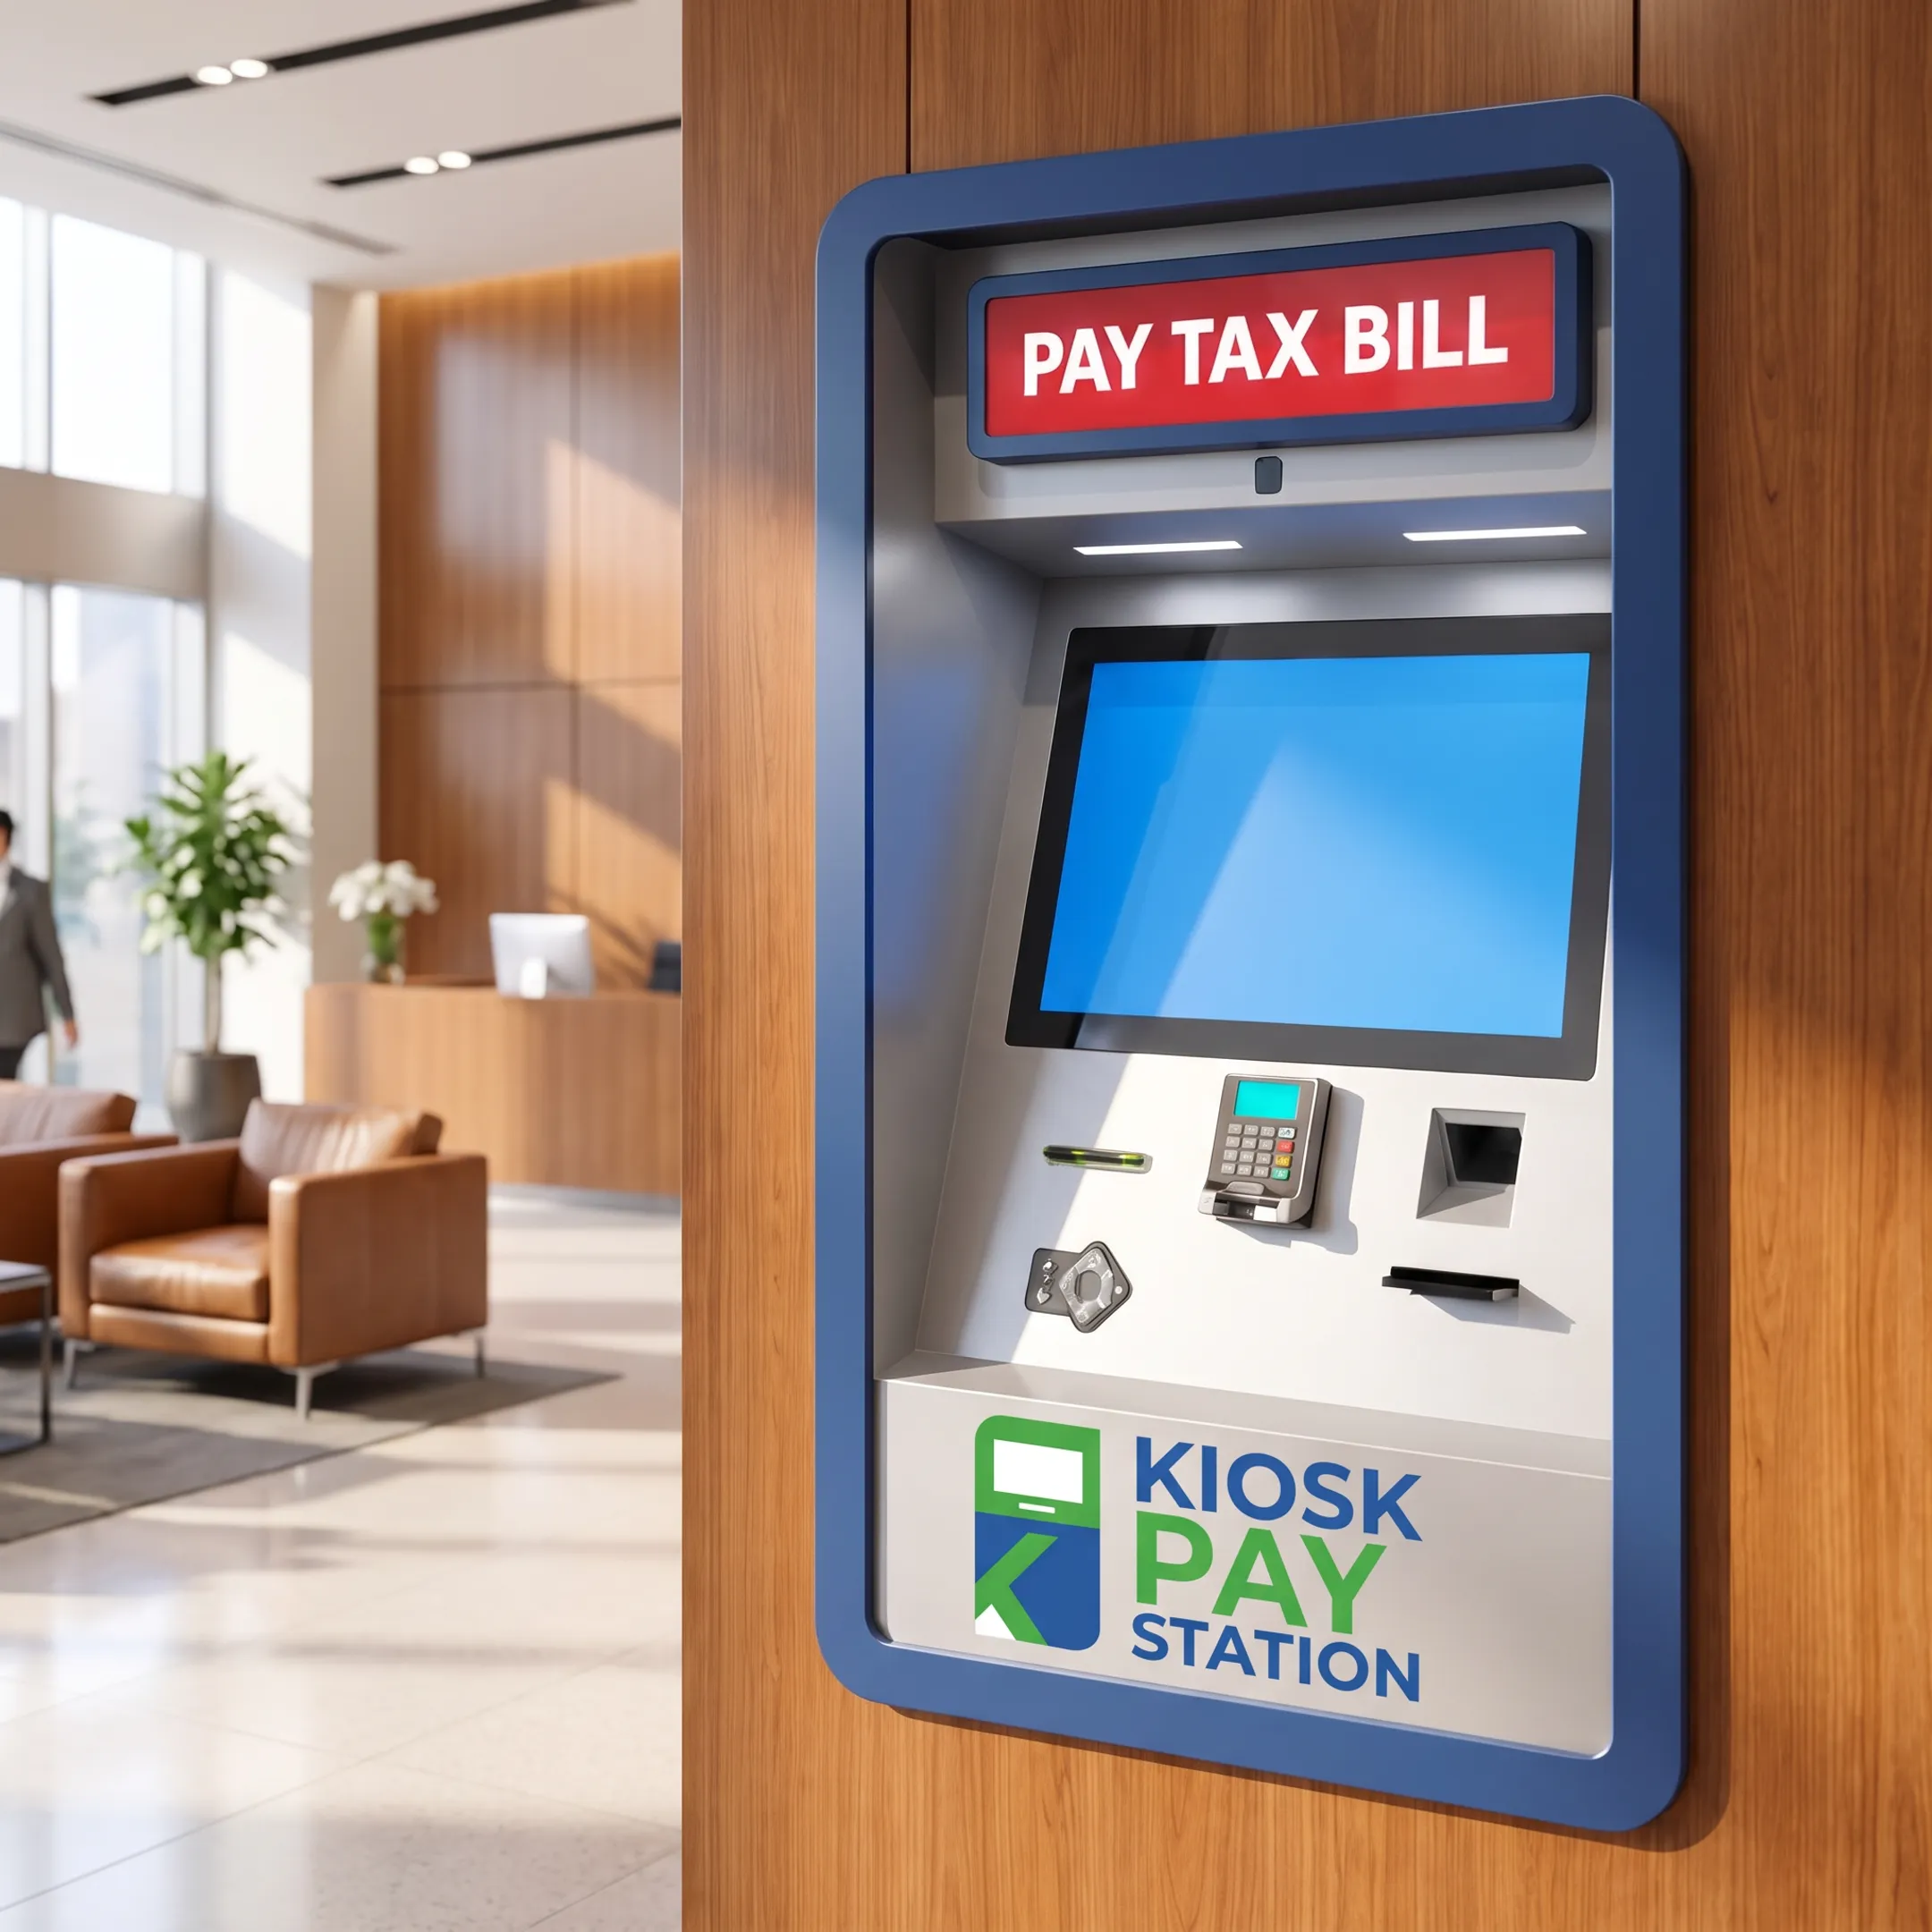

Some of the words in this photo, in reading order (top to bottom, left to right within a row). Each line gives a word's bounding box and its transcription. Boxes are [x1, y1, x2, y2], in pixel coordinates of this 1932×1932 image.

[1023, 323, 1154, 396] PAY
[1171, 309, 1320, 386] TAX
[1343, 294, 1509, 375] BILL
[1136, 1436, 1423, 1542] KIOSK
[1136, 1511, 1387, 1634] PAY
[1131, 1613, 1420, 1702] STATION
